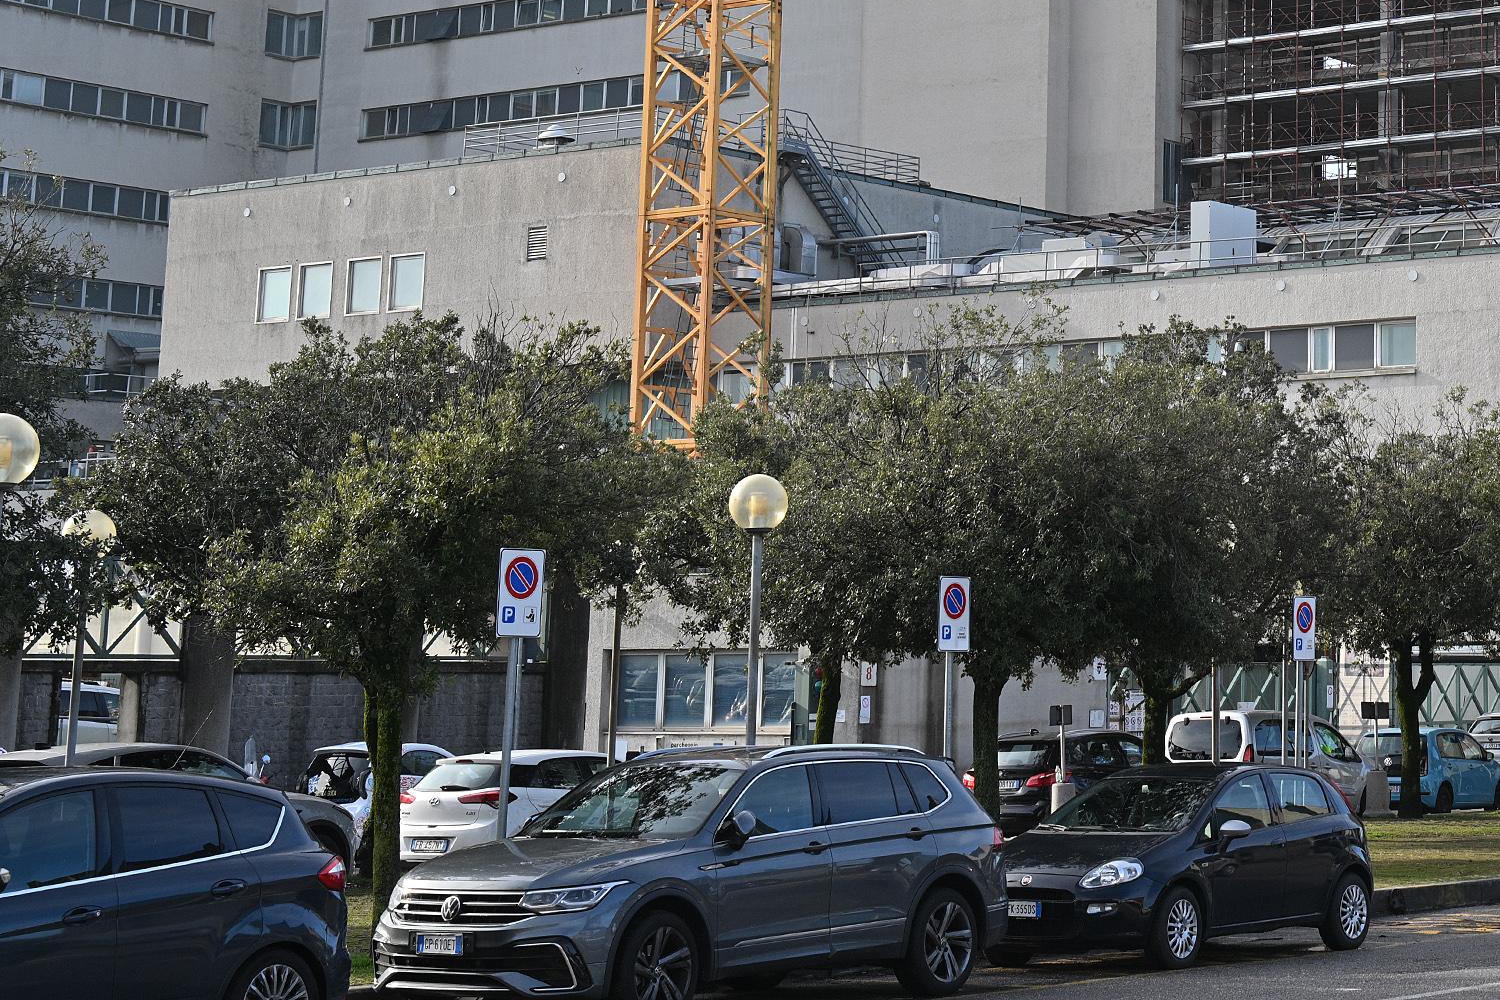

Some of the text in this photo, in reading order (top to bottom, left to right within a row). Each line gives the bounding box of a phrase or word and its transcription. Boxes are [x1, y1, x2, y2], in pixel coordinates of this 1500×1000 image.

[504, 607, 514, 622] P
[943, 626, 950, 639] P
[866, 666, 872, 680] 8
